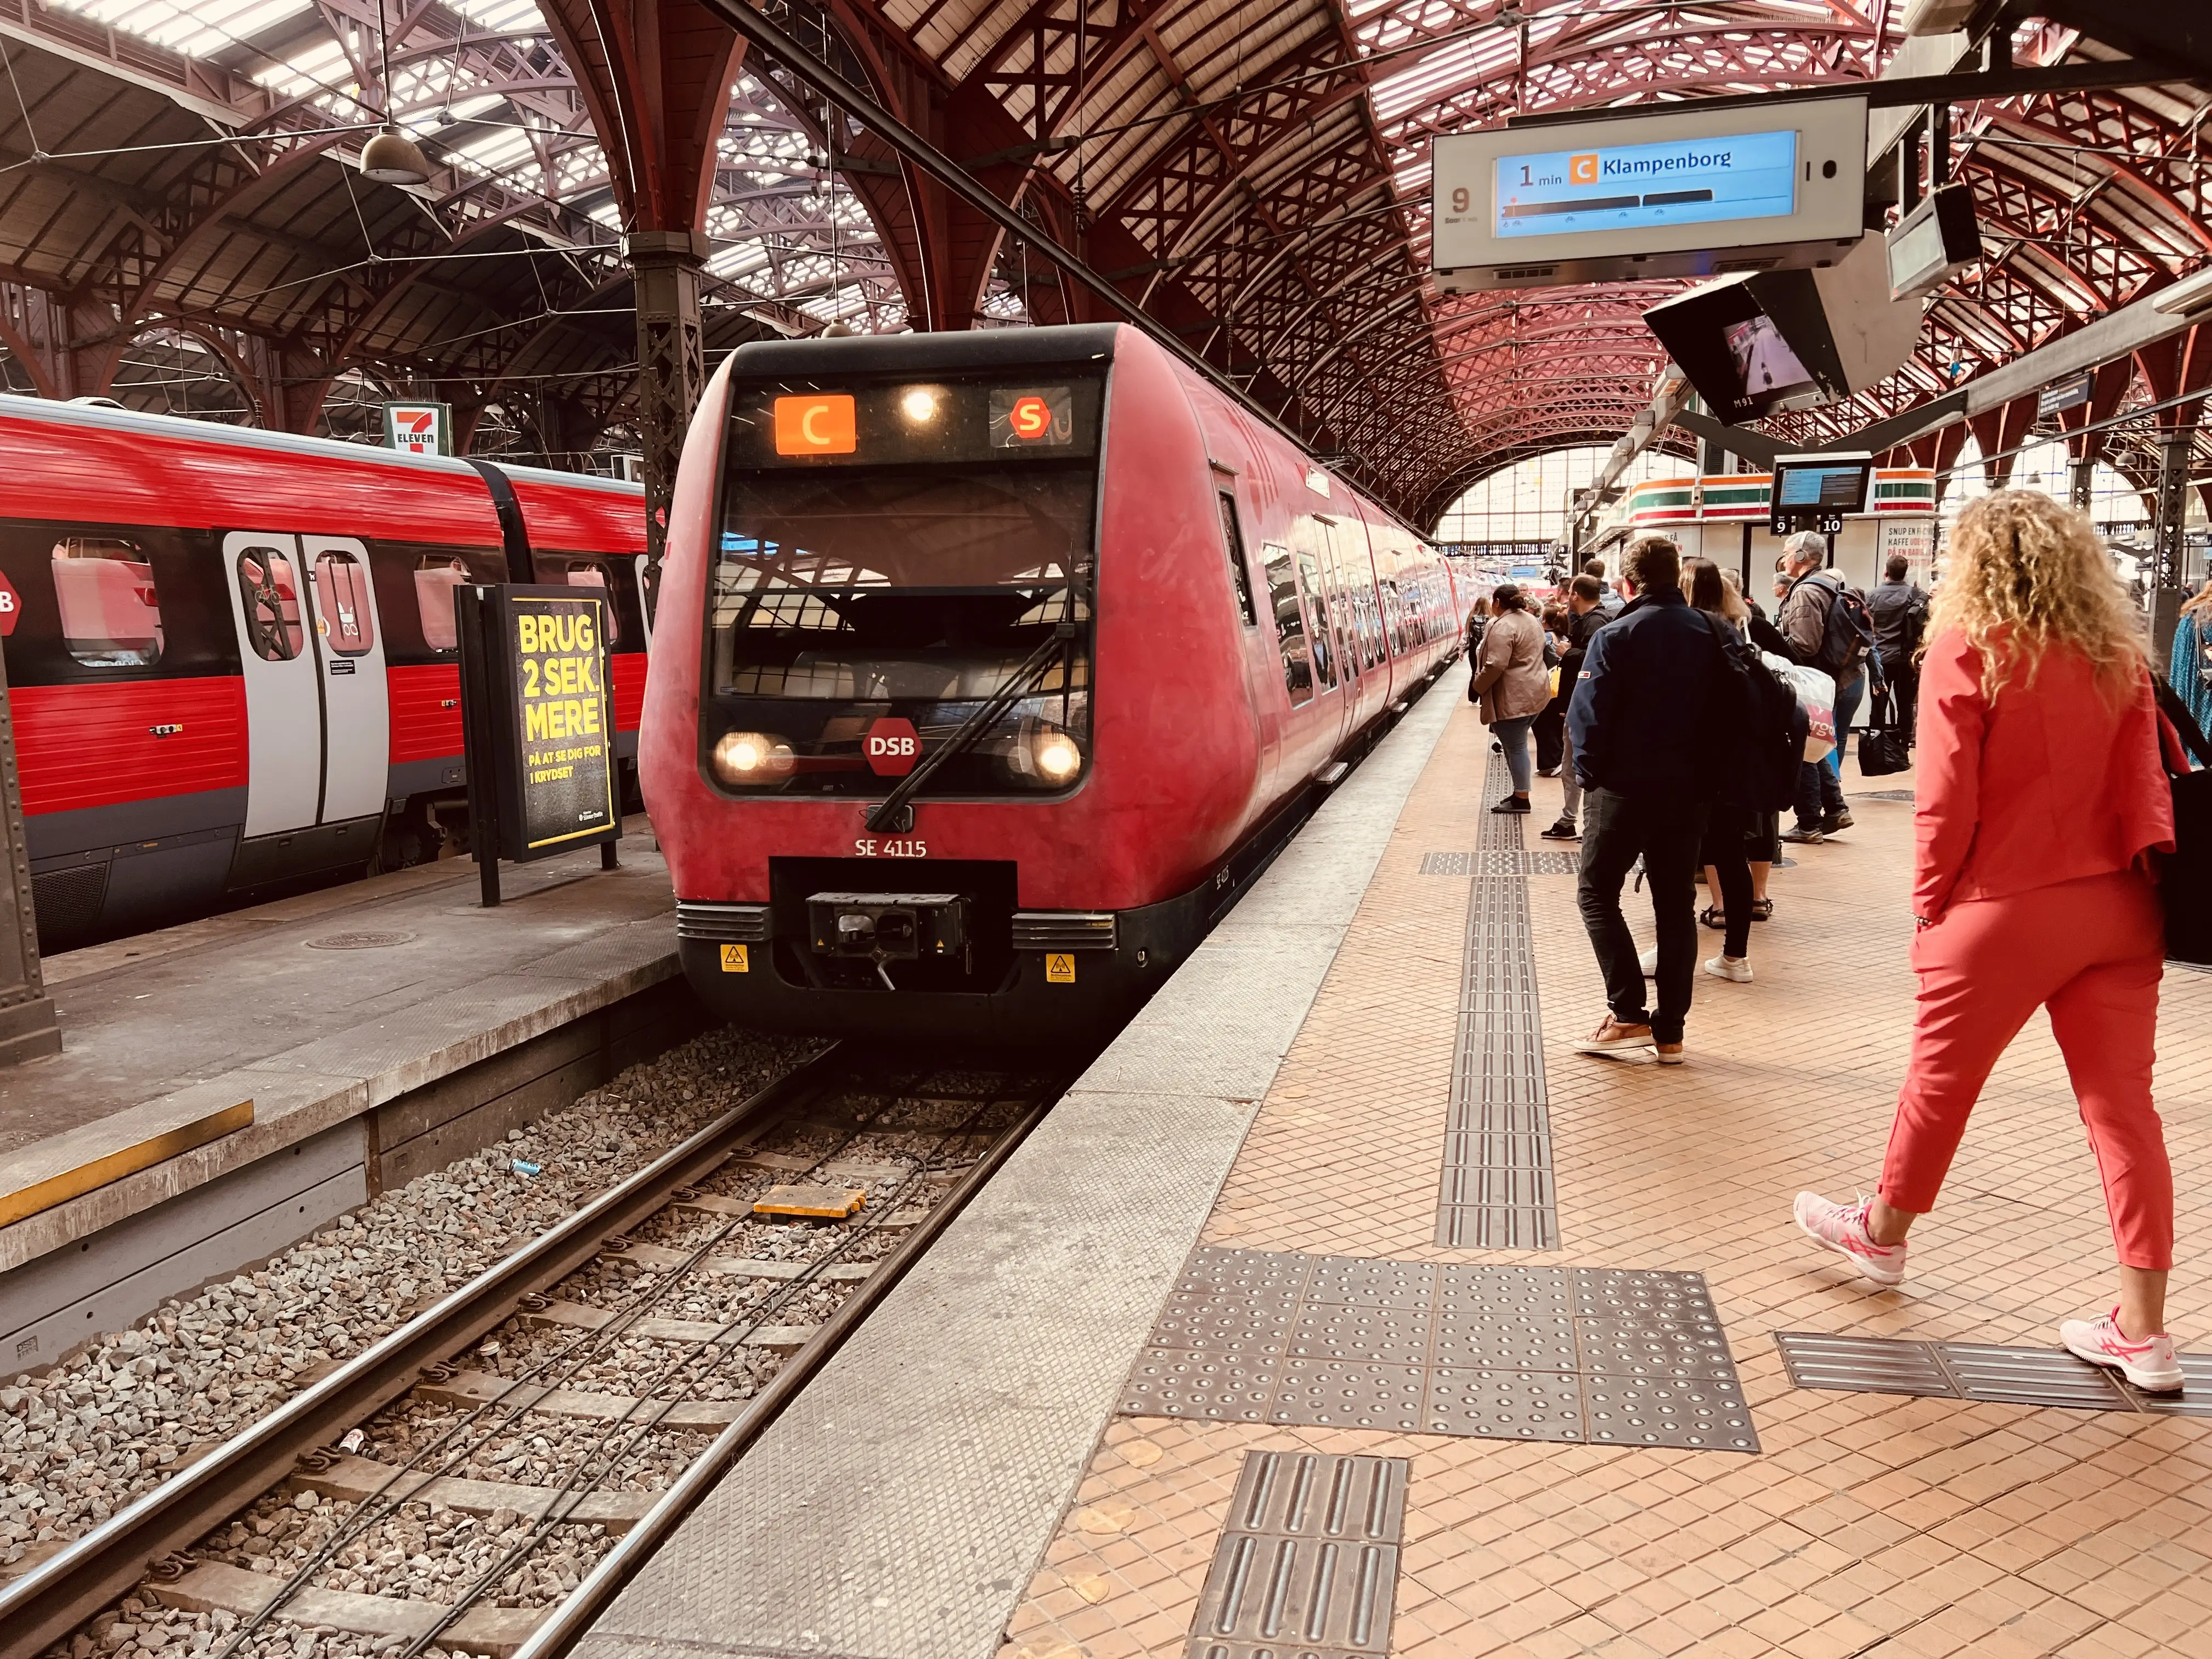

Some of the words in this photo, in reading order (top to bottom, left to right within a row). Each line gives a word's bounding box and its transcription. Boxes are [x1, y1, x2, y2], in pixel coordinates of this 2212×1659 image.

[1520, 165, 1534, 187] 1
[1538, 175, 1562, 187] min
[1577, 160, 1592, 179] C
[1602, 151, 1732, 176] Klampenborg
[1452, 187, 1470, 214] 9
[1733, 396, 1754, 408] M91
[802, 405, 830, 445] C
[1019, 404, 1041, 431] S
[396, 411, 433, 454] 7
[1777, 522, 1786, 533] 9
[1823, 520, 1841, 532] 10
[1888, 527, 1907, 535] SNUP
[1908, 527, 1915, 535] EN
[1670, 532, 1678, 542] FÅ
[1888, 538, 1909, 546] KAFFE
[1887, 546, 1896, 556] PÅ
[518, 614, 595, 653] BRUG
[522, 658, 541, 698] 2
[544, 656, 600, 696] SEK.
[525, 697, 600, 742] MERE
[528, 751, 541, 767] PÅ
[542, 752, 554, 765] AT
[555, 749, 567, 763] SE
[567, 747, 583, 760] DIG
[584, 744, 601, 758] FOR
[870, 737, 915, 756] DSB
[530, 772, 534, 785] I
[534, 765, 574, 784] KRYDSET
[855, 839, 877, 856] SE
[883, 839, 927, 858] 4115
